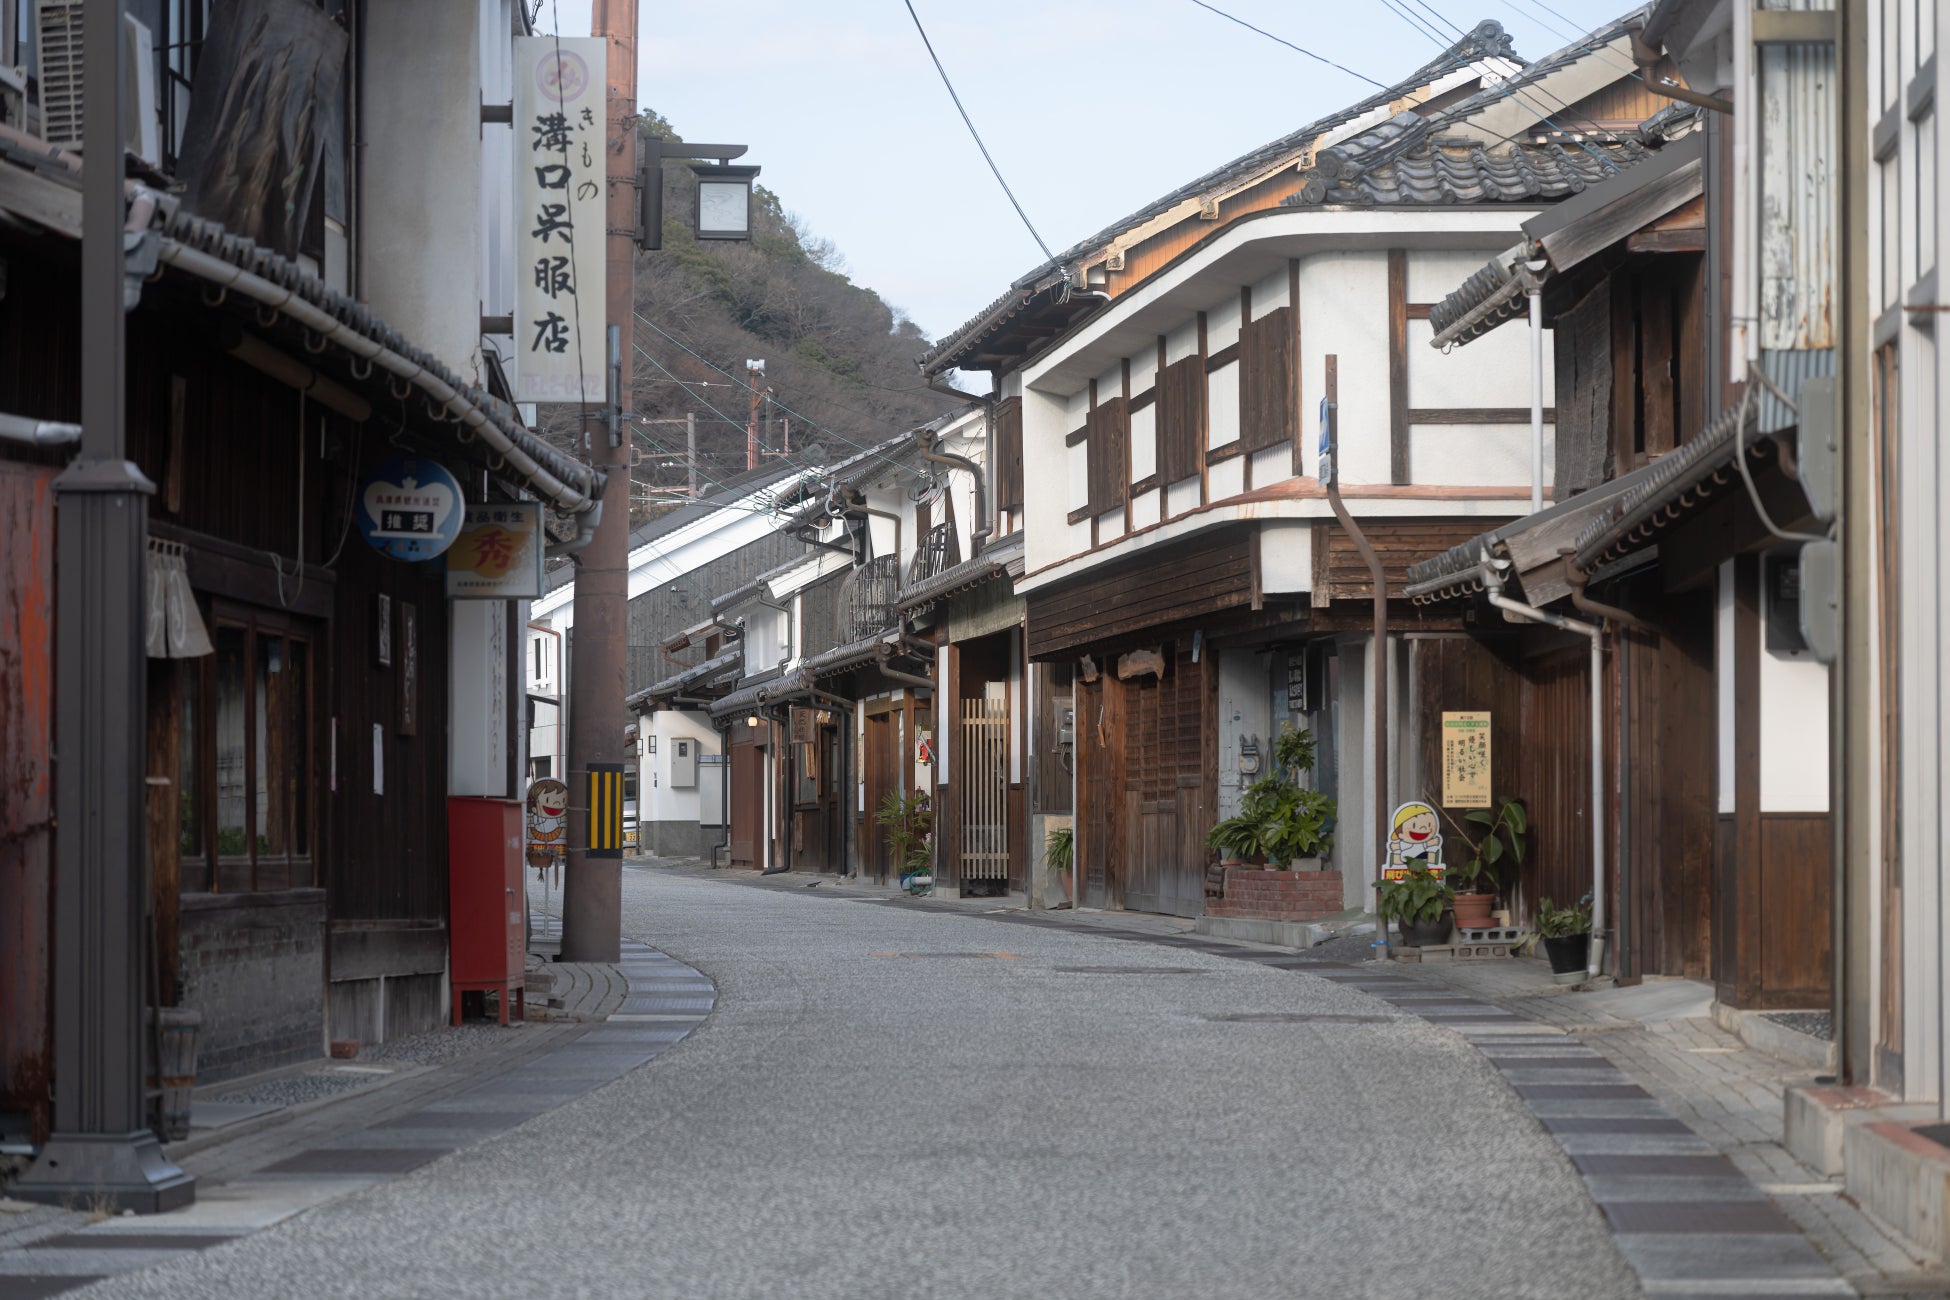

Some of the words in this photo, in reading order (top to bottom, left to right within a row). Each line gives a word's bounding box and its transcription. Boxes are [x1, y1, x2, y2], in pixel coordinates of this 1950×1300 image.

[578, 106, 599, 202] きもの
[531, 112, 576, 354] 溝口呉服店
[472, 529, 513, 570] 秀
[1457, 739, 1466, 782] 明るい社会
